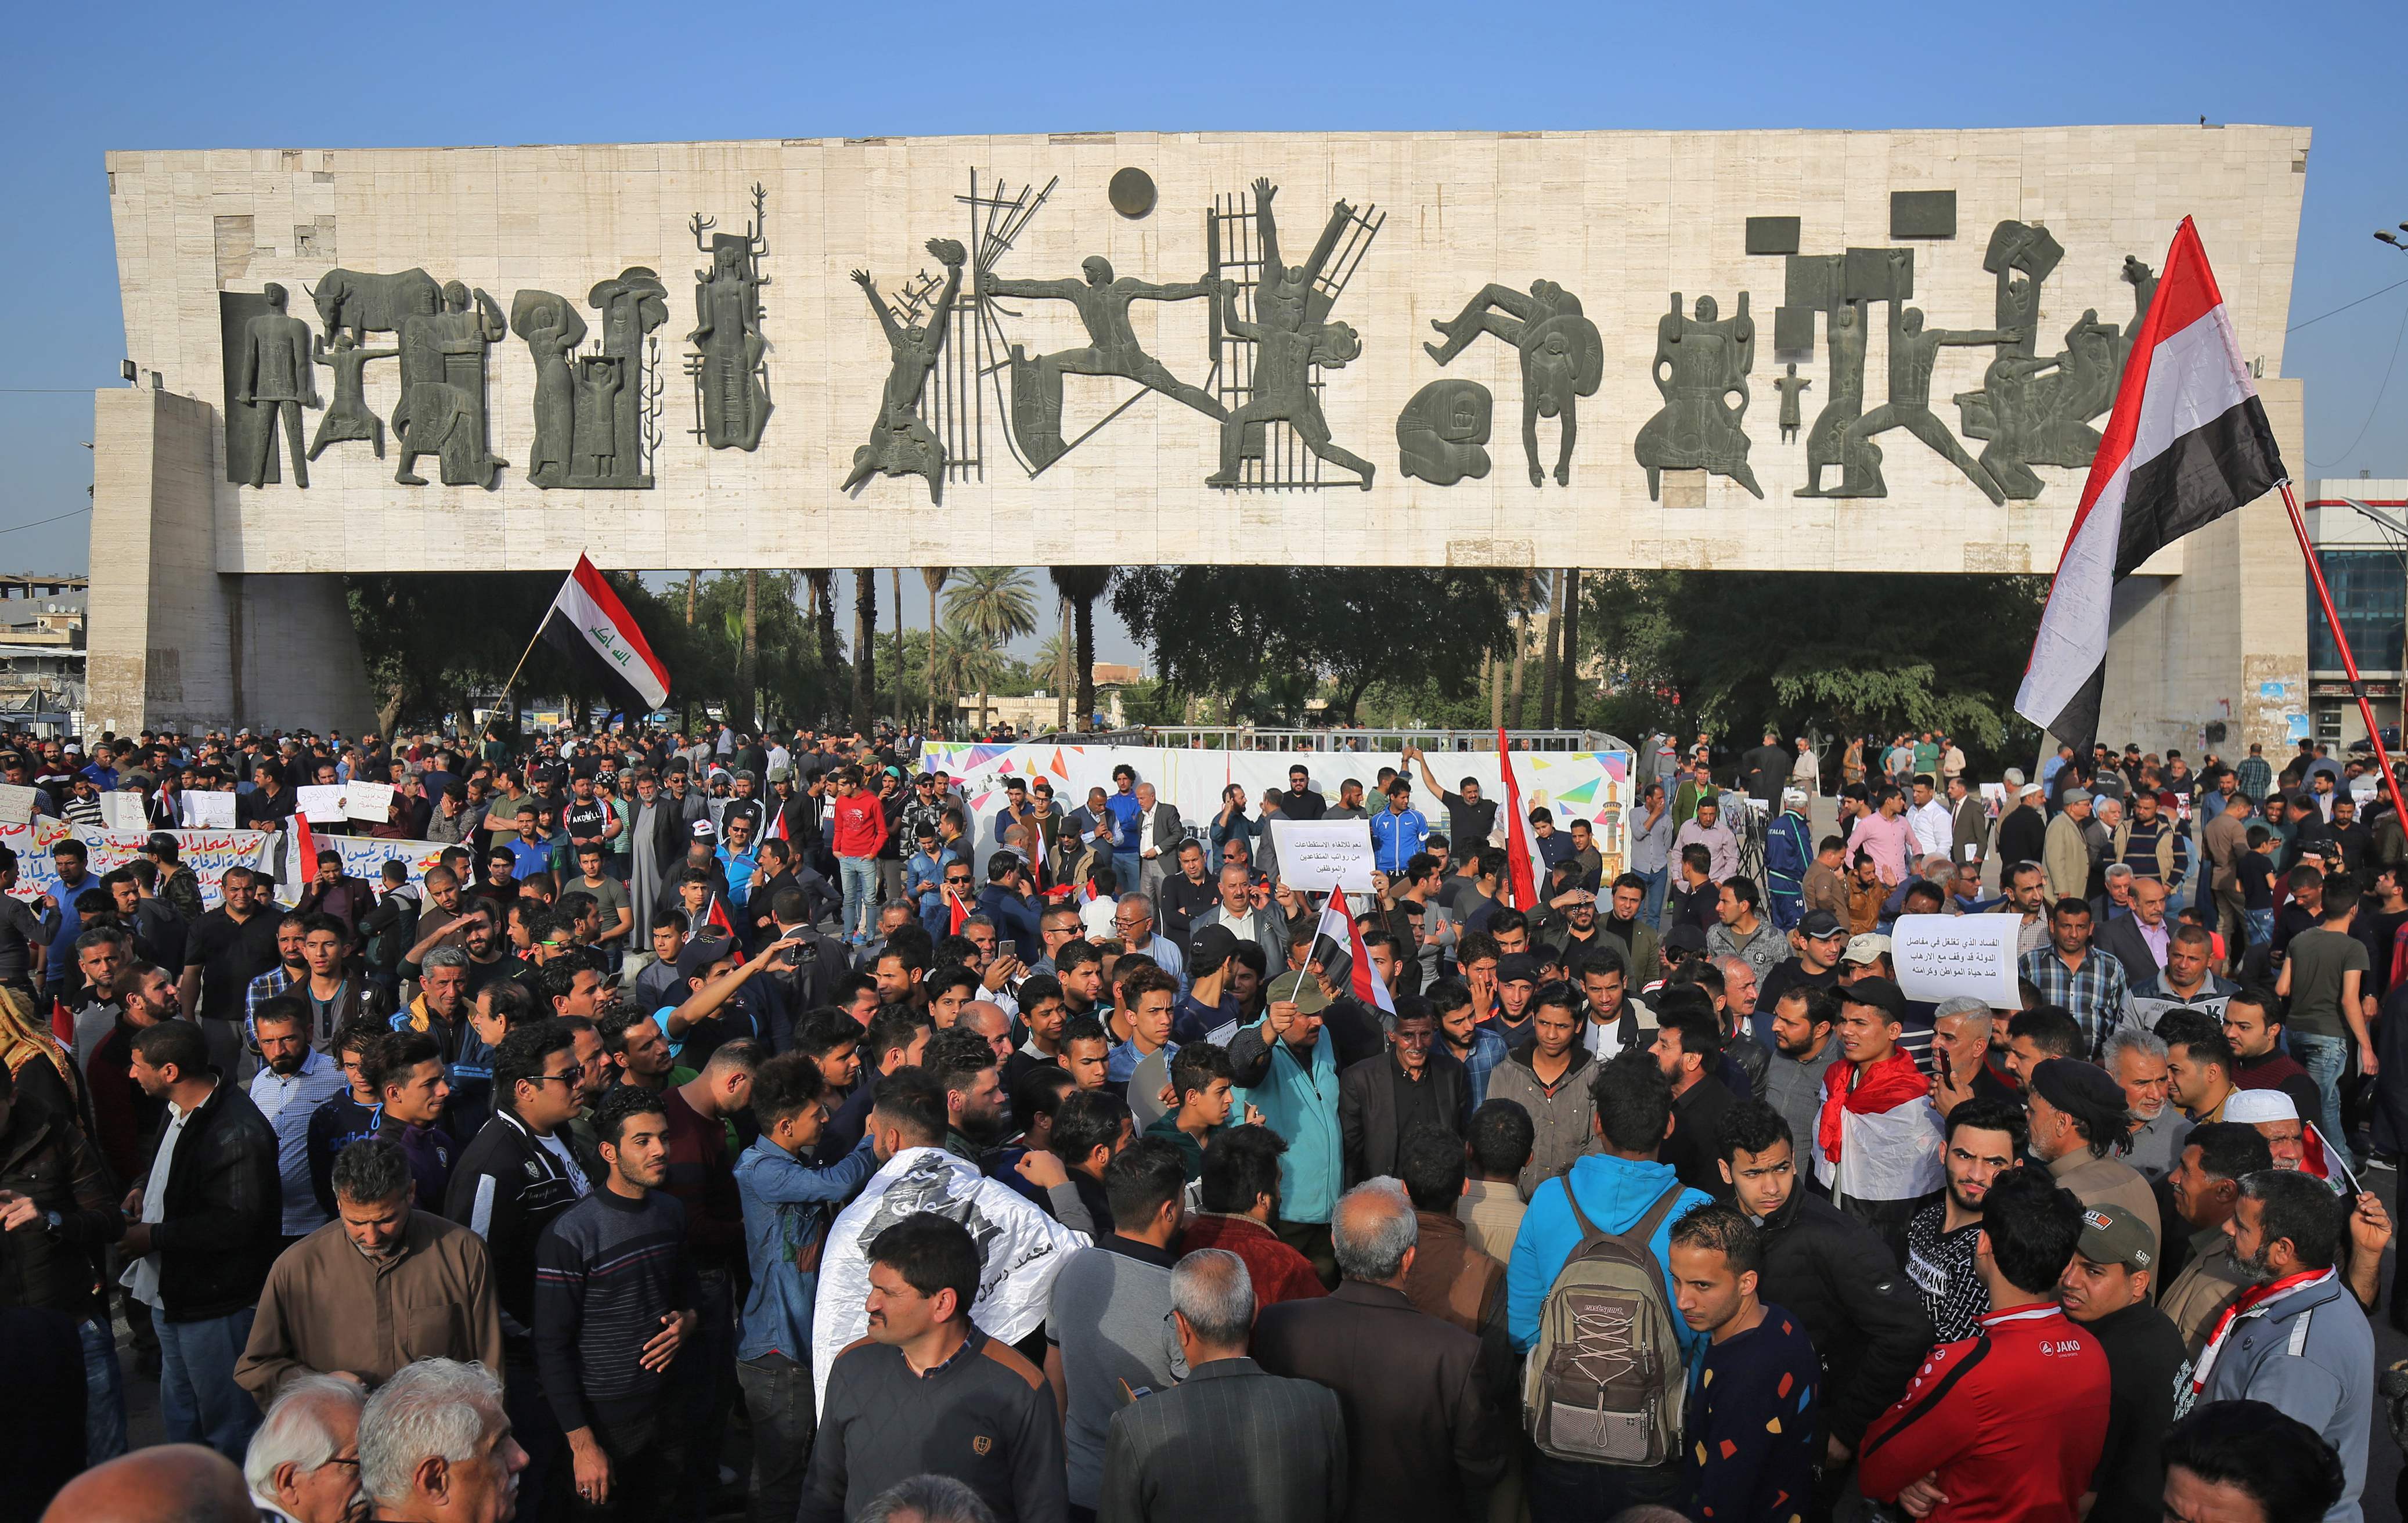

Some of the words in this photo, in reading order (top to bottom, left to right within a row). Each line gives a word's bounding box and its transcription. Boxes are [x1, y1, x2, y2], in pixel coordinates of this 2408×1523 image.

[237, 833, 259, 856] نحن
[1352, 842, 1361, 850] نعم
[347, 842, 381, 862] رئيس
[1300, 853, 1329, 862] المتقاعدين
[1316, 864, 1346, 874] والموظفين
[1906, 937, 1928, 947] مفاصل
[1931, 937, 1940, 948] في
[1942, 938, 1960, 947] تغلغل
[1962, 938, 1977, 949] الذي
[1979, 939, 2000, 947] الفساد
[1910, 951, 1935, 962] الارهاب
[1949, 952, 1965, 963] وقف
[1967, 952, 1974, 962] قد
[1976, 953, 1996, 963] الدولة
[1912, 966, 1938, 977] وكرامته
[1940, 967, 1966, 977] المواطن
[1967, 967, 1982, 977] حياة
[1984, 968, 1996, 977] ضد
[329, 1131, 369, 1150] adid
[1014, 1243, 1054, 1270] محمد
[978, 1269, 1010, 1303] رسول
[2056, 1340, 2081, 1352] JAKO
